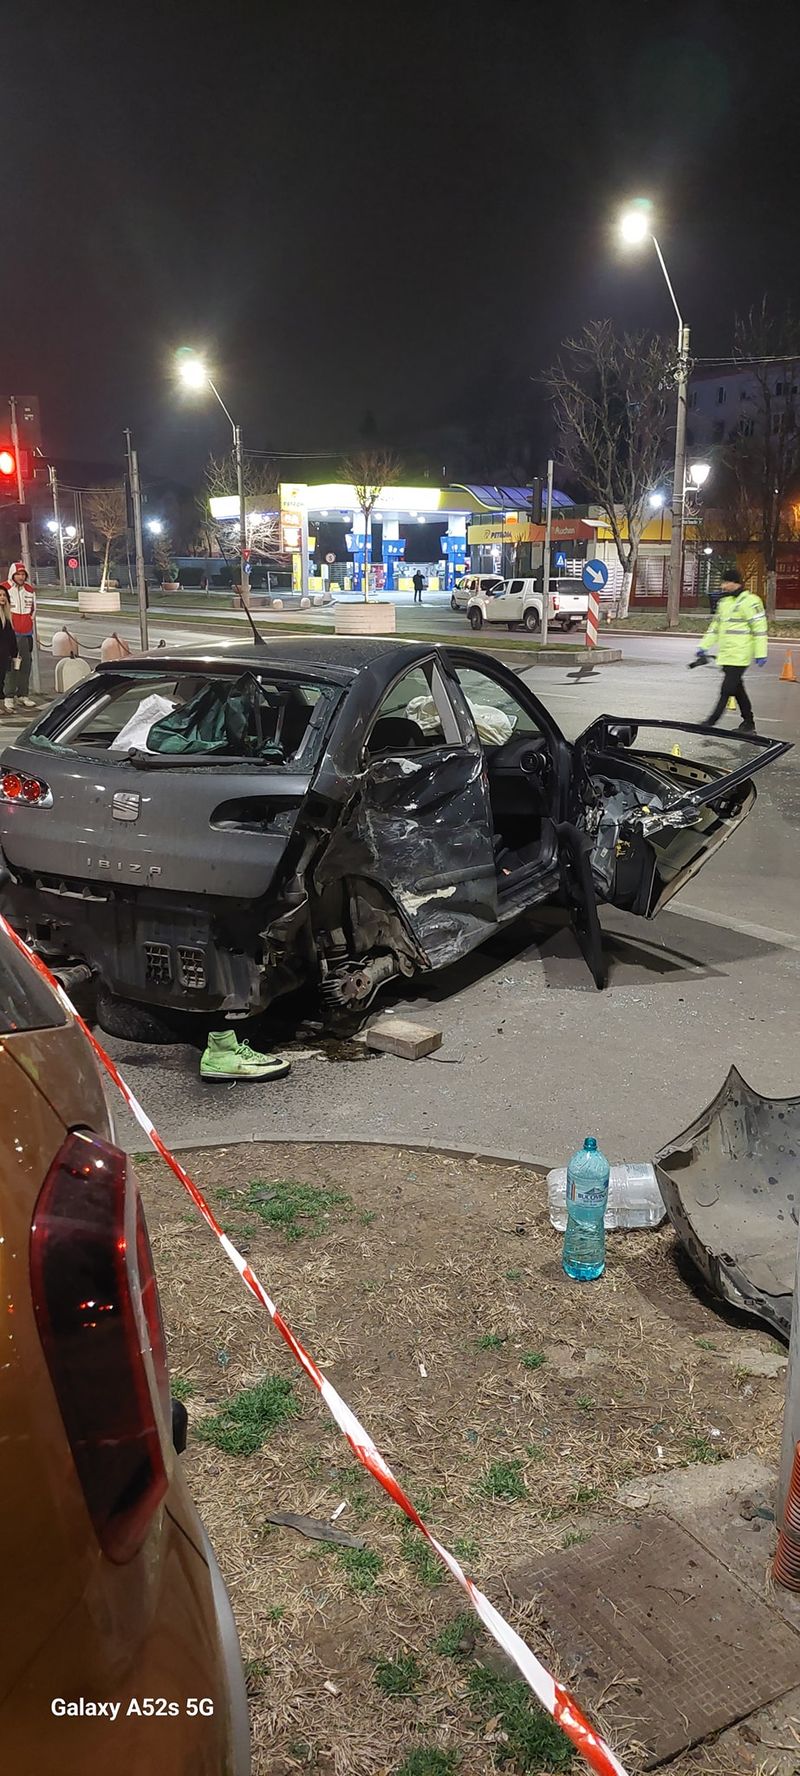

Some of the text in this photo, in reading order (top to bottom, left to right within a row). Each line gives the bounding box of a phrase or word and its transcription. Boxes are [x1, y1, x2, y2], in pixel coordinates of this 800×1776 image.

[554, 526, 575, 535] Auchan
[87, 858, 163, 876] IBIZA
[577, 1192, 606, 1201] BUCOVIN
